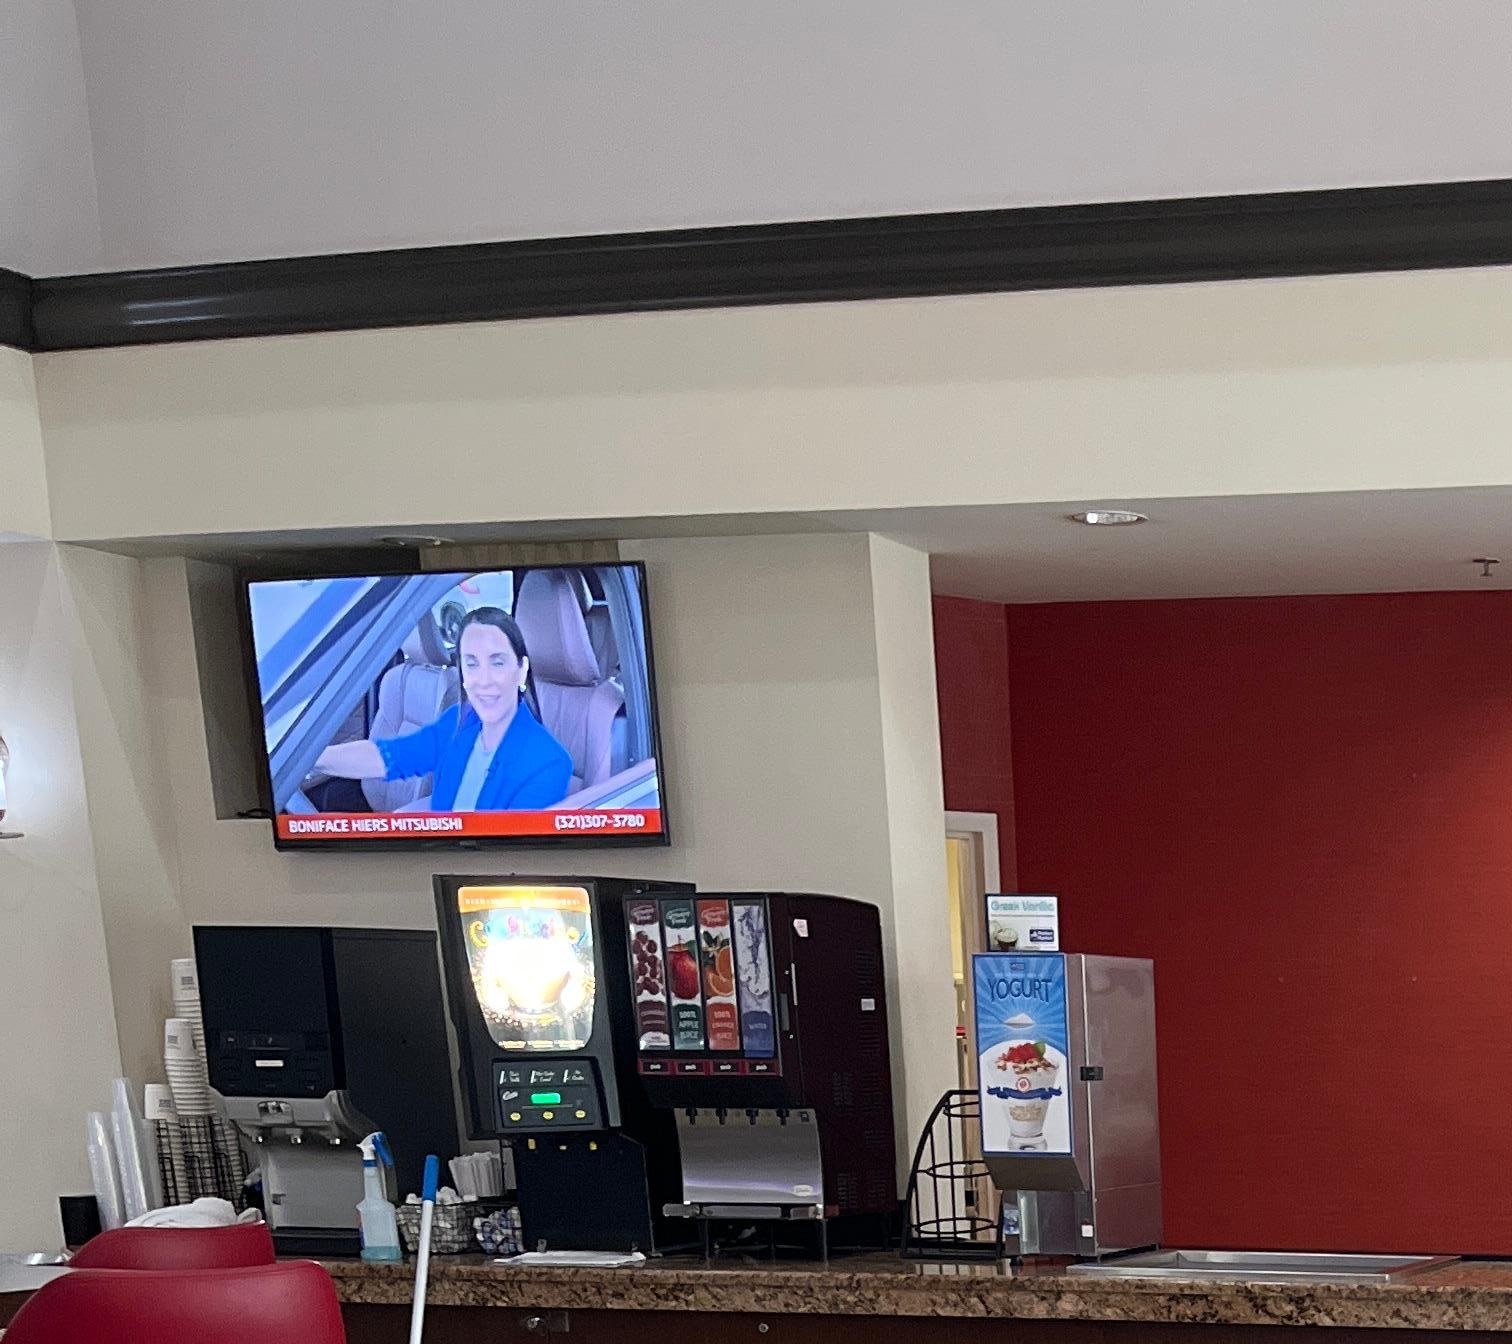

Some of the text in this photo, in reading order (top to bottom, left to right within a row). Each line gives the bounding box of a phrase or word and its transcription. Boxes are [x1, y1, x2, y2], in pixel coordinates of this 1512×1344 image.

[289, 817, 463, 833] BONIFACE HIERS MITSUBISHI
[554, 814, 645, 831] (321)307-3780
[987, 978, 1053, 1003] YOGURT
